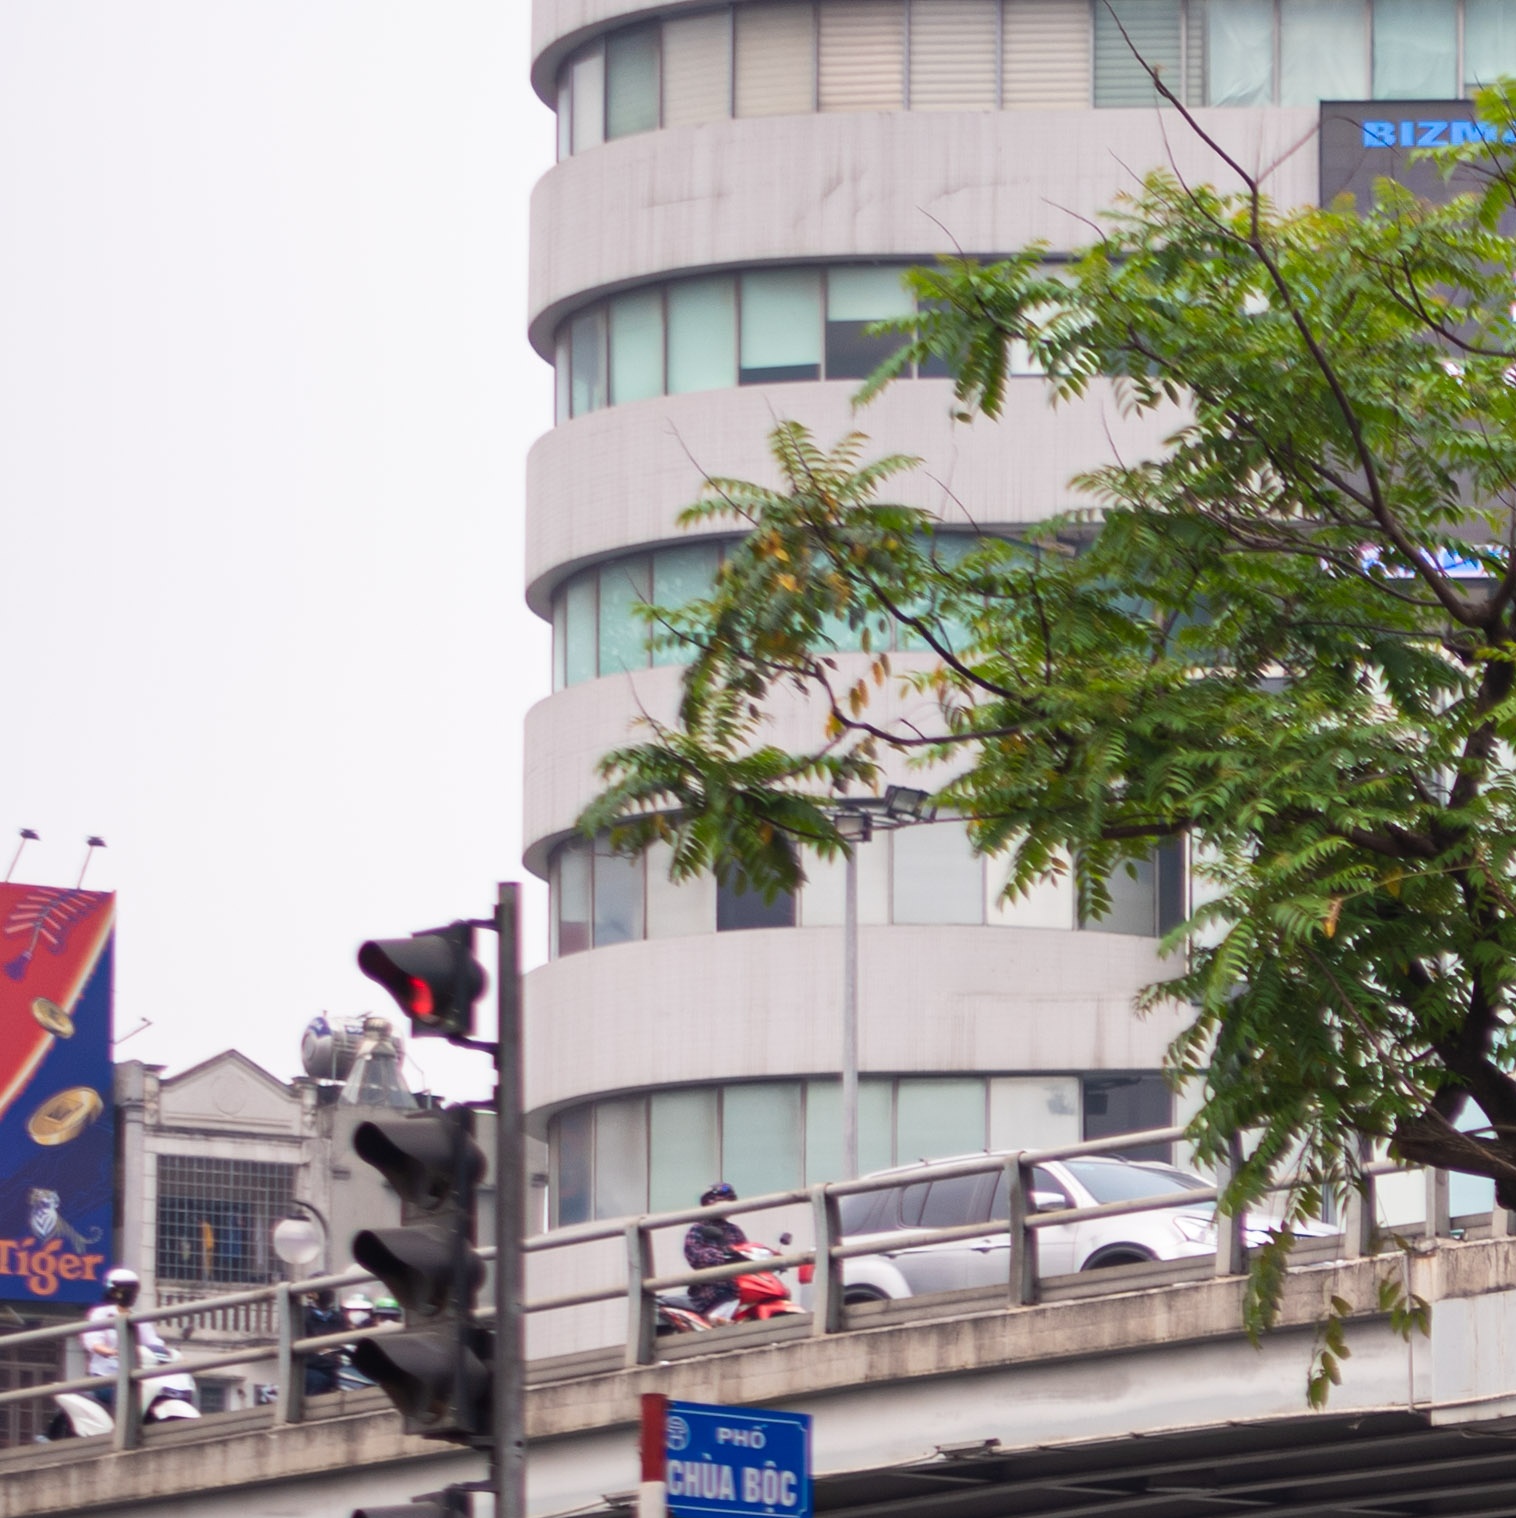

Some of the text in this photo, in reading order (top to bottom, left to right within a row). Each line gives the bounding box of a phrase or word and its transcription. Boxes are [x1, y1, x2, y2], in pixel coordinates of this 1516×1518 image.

[715, 1423, 769, 1450] PHỐ
[667, 1452, 798, 1514] CHÙA BỘC
